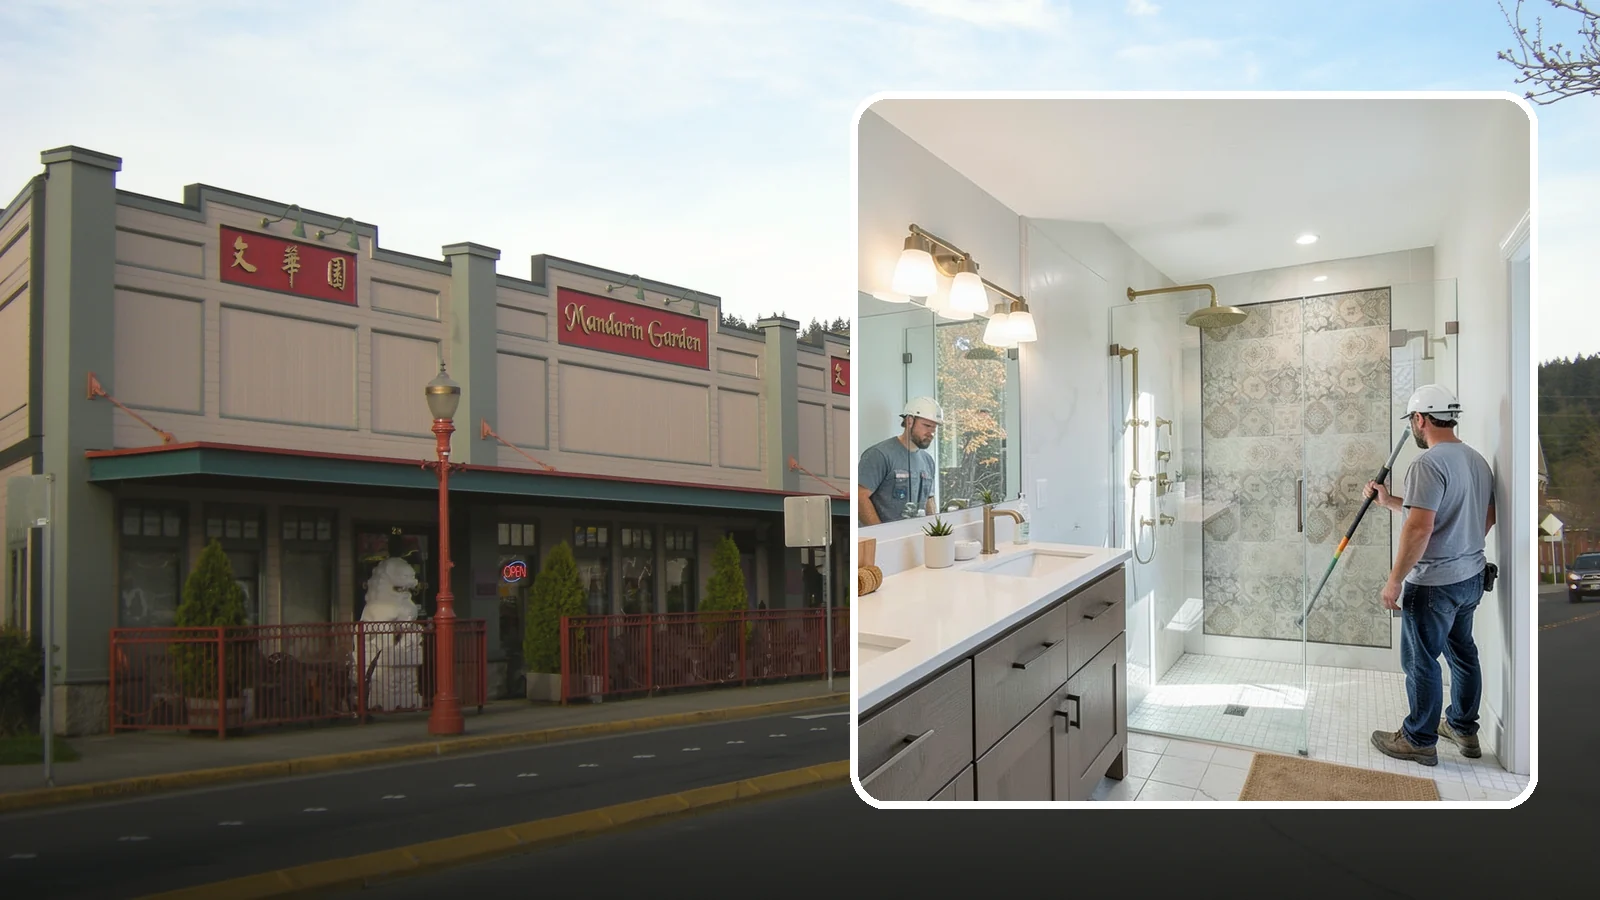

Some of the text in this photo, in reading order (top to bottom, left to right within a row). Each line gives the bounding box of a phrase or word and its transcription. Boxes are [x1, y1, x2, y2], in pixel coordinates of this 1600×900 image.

[230, 236, 346, 291] 文華園
[564, 302, 702, 352] Mandarin Garden
[503, 565, 527, 578] OPEN
